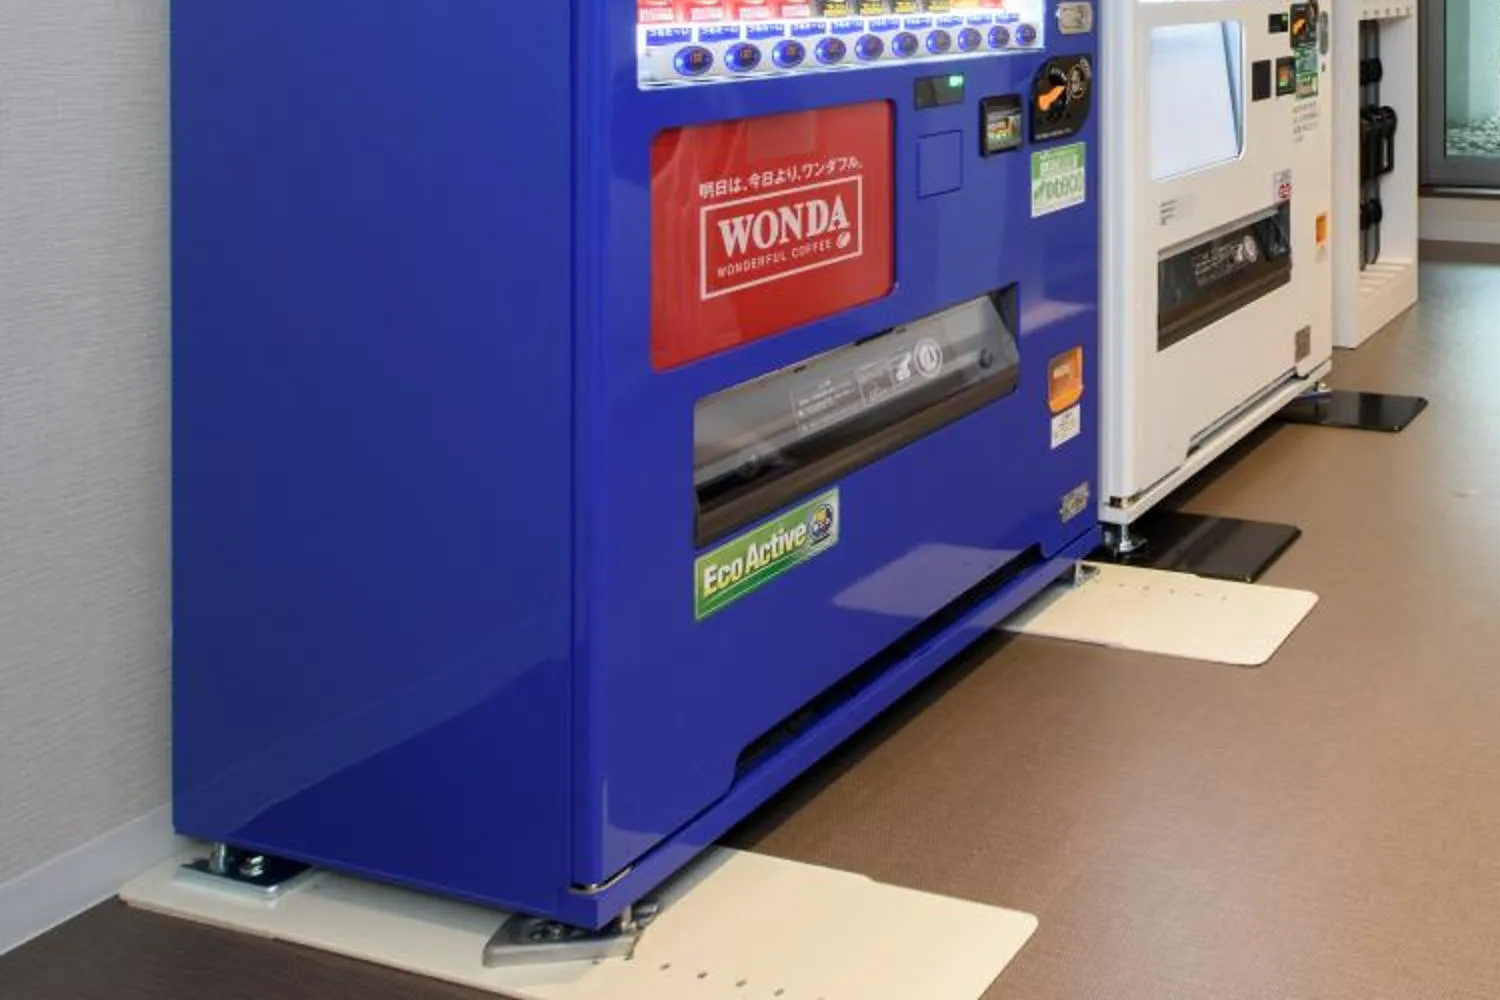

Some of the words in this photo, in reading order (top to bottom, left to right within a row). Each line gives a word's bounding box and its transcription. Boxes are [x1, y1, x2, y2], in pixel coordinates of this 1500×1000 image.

[717, 193, 850, 258] WONDA
[717, 252, 786, 278] WONDERFUL
[791, 238, 832, 258] COFFEE
